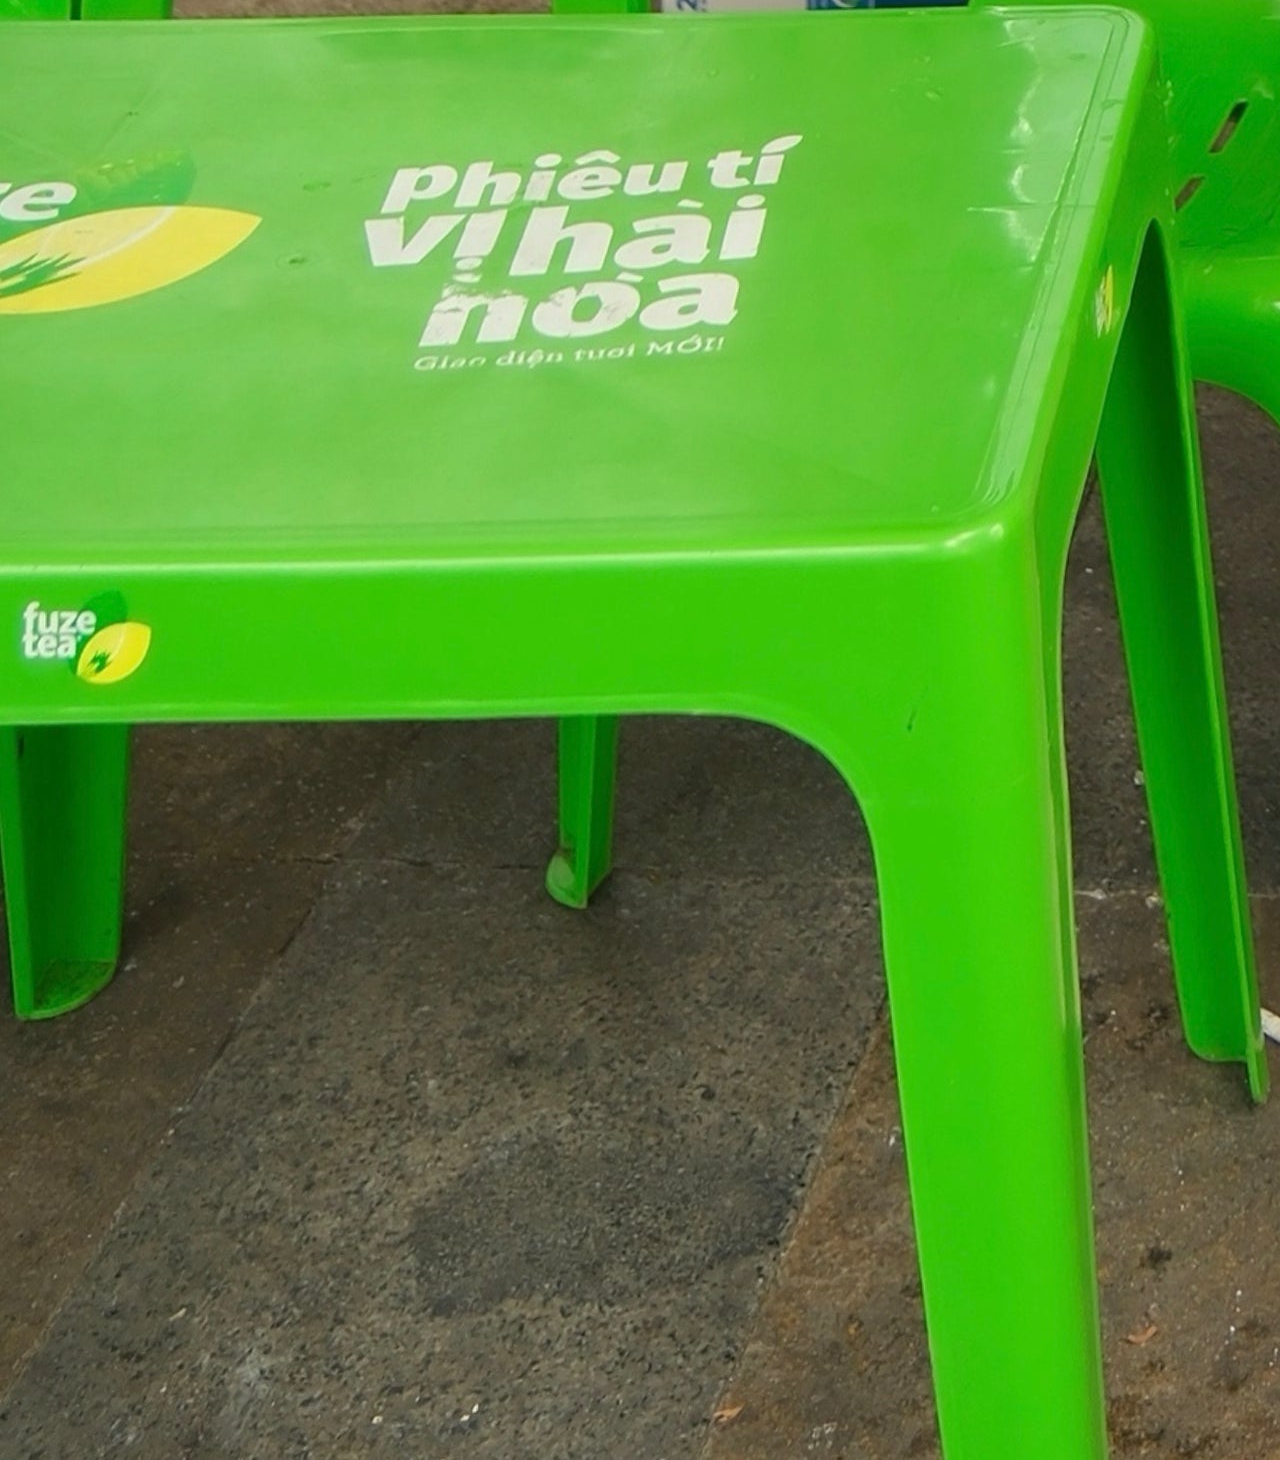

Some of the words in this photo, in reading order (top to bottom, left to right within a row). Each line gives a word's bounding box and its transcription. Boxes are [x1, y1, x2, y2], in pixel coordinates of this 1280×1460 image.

[380, 150, 690, 213] Phiêu
[707, 135, 803, 189] tí
[508, 194, 768, 277] hài
[496, 347, 564, 369] diện
[23, 601, 97, 635] fuze
[22, 632, 77, 659] tea
